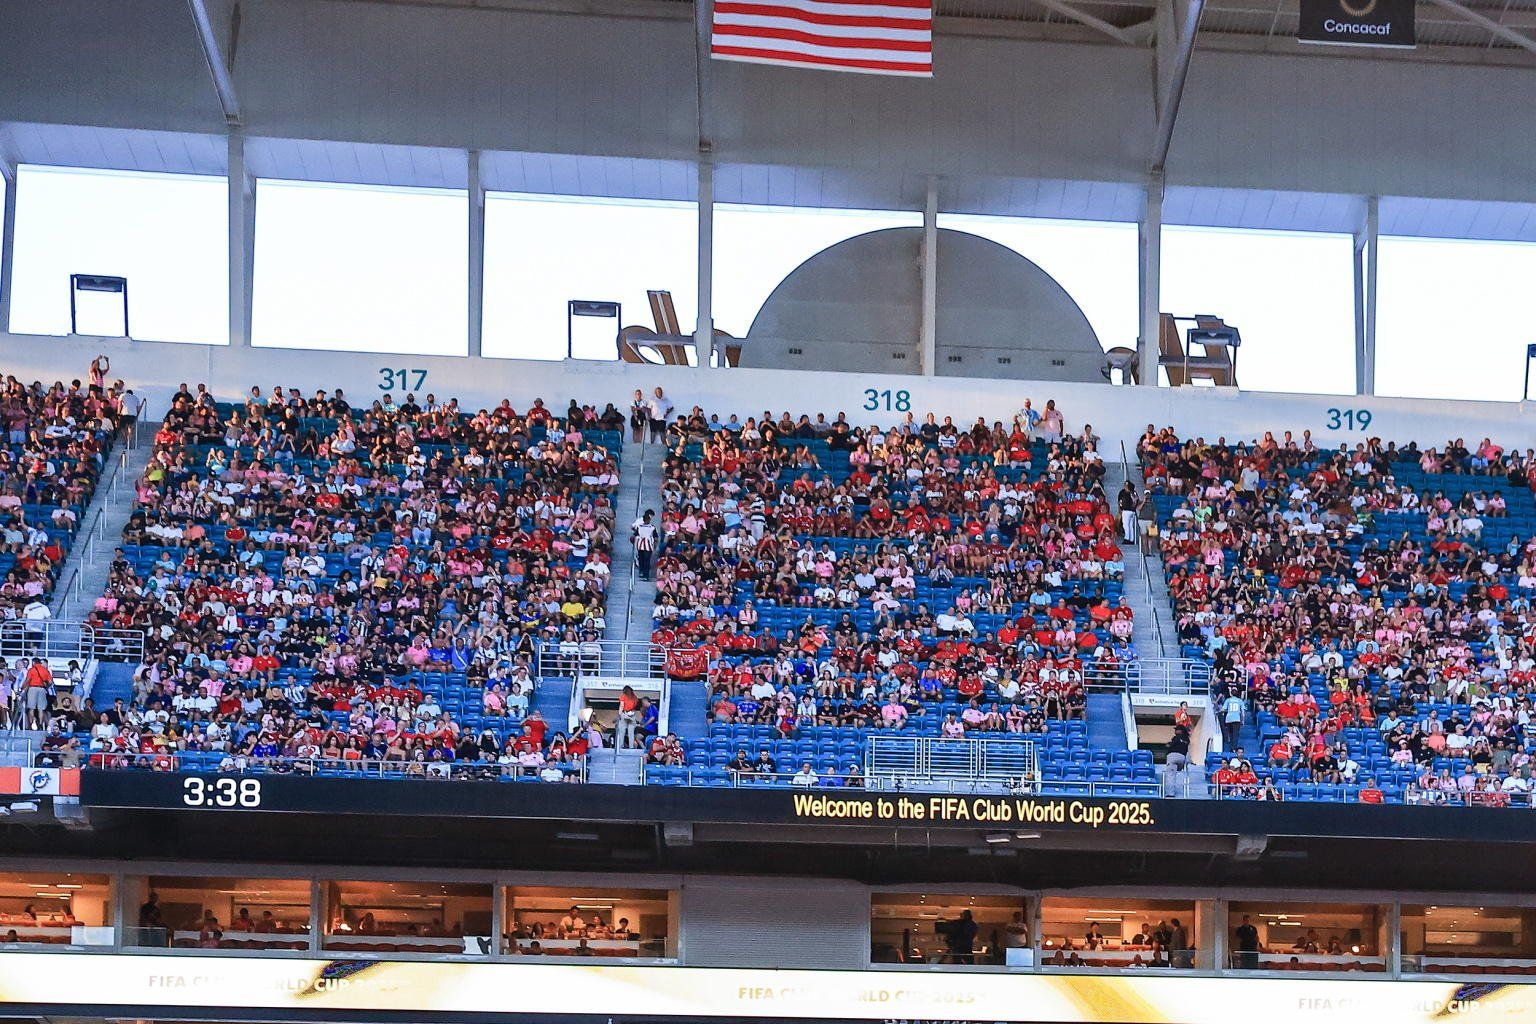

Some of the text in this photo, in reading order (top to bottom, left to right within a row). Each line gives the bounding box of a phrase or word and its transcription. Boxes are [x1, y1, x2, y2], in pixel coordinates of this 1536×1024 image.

[1324, 19, 1392, 36] Concacaf
[378, 367, 427, 392] 317
[863, 388, 911, 412] 318
[1326, 408, 1372, 431] 319
[183, 777, 261, 807] 3:38
[793, 794, 1155, 828] Welcome to the FIFA Club World Cup 2025.
[148, 976, 187, 988] FIFA
[738, 986, 774, 1000] FIFA
